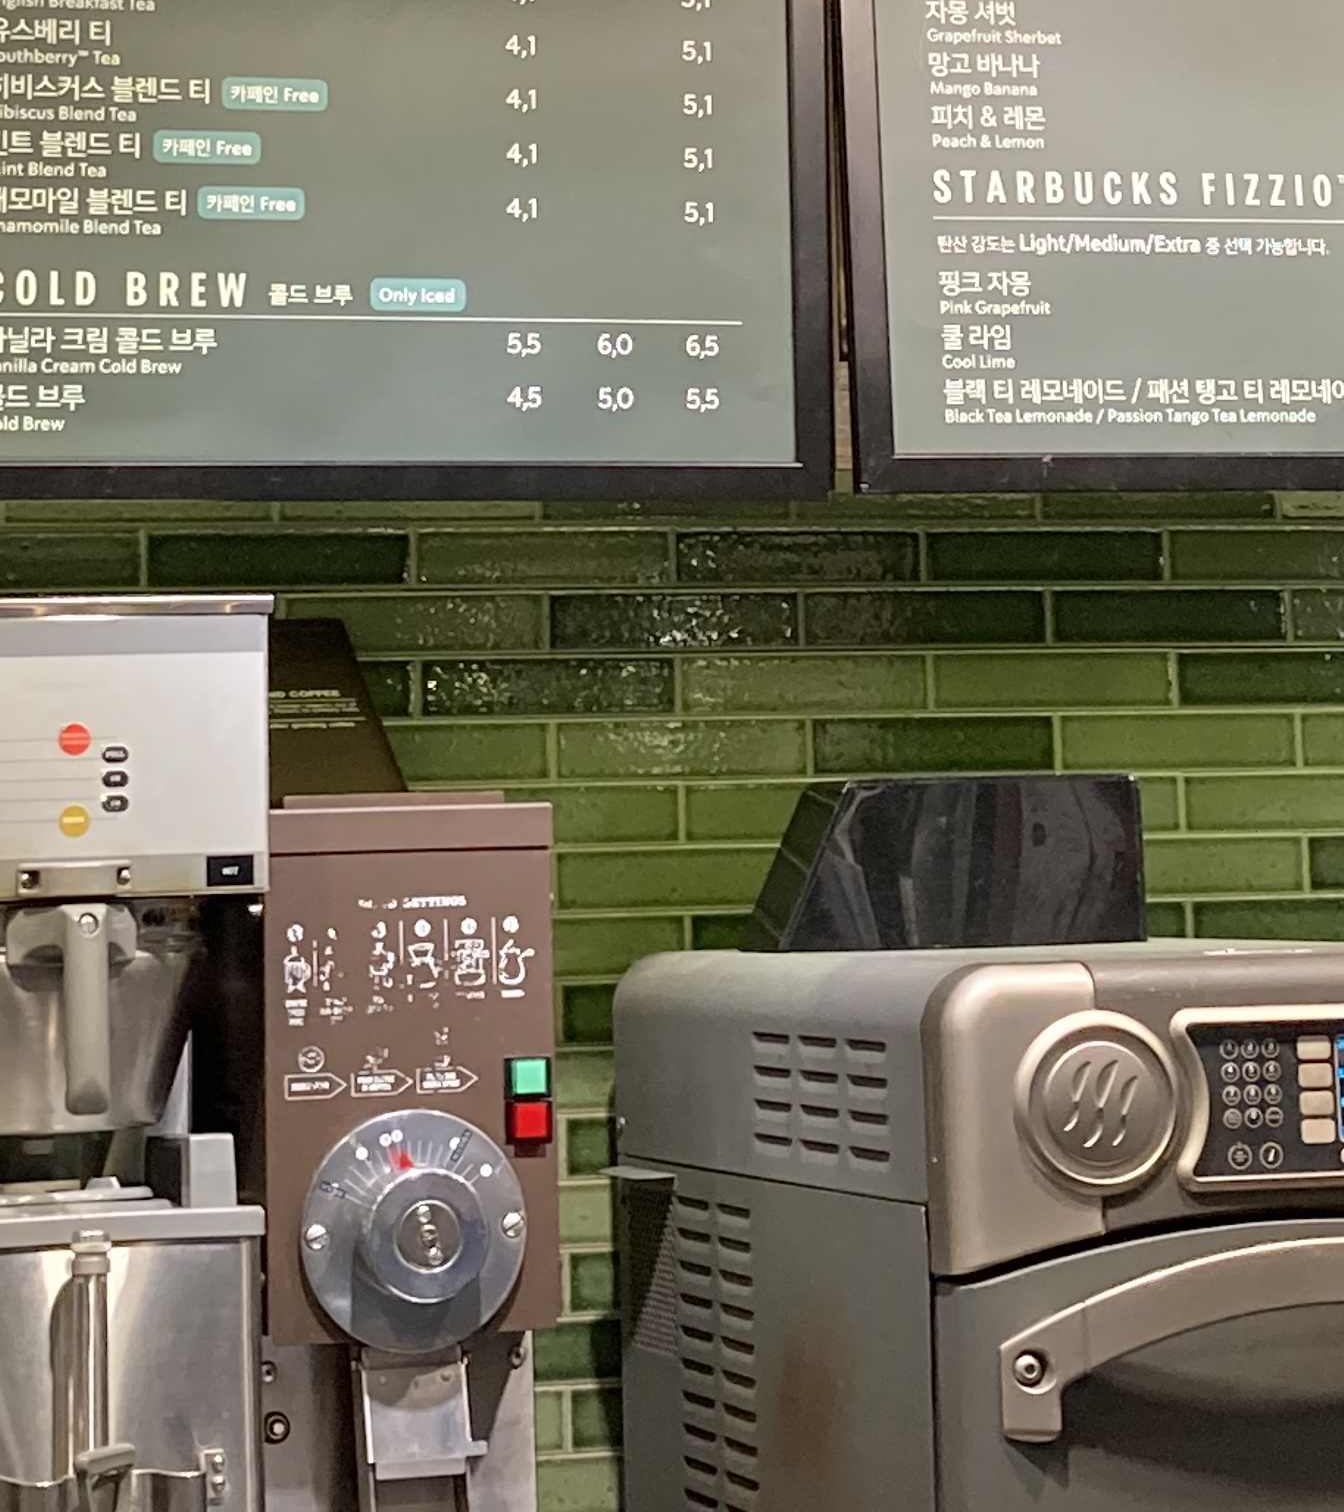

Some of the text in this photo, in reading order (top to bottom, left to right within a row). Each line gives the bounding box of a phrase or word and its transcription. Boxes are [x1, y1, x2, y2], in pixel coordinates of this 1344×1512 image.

[972, 0, 1016, 26] 셔벗
[925, 26, 1062, 45] Grapefruit Sherbet
[930, 103, 1046, 131] 피치 & 레몬
[931, 132, 1045, 149] Peach & Lemon
[932, 168, 1178, 205] STARBUCKS
[125, 270, 247, 308] BREW
[267, 282, 309, 306] 콜드
[312, 283, 353, 306] 브루
[377, 285, 418, 306] Only
[420, 286, 455, 304] Iced
[59, 326, 108, 354] 크림
[114, 326, 164, 355] 콜드
[167, 327, 218, 355] 브루
[940, 323, 1011, 351] 쿨 라임
[40, 356, 96, 374] Cream
[97, 357, 137, 374] Cold
[139, 357, 183, 374] Brew
[941, 352, 1016, 369] Cool Lime
[34, 383, 86, 411] 브루
[22, 414, 65, 431] Brew
